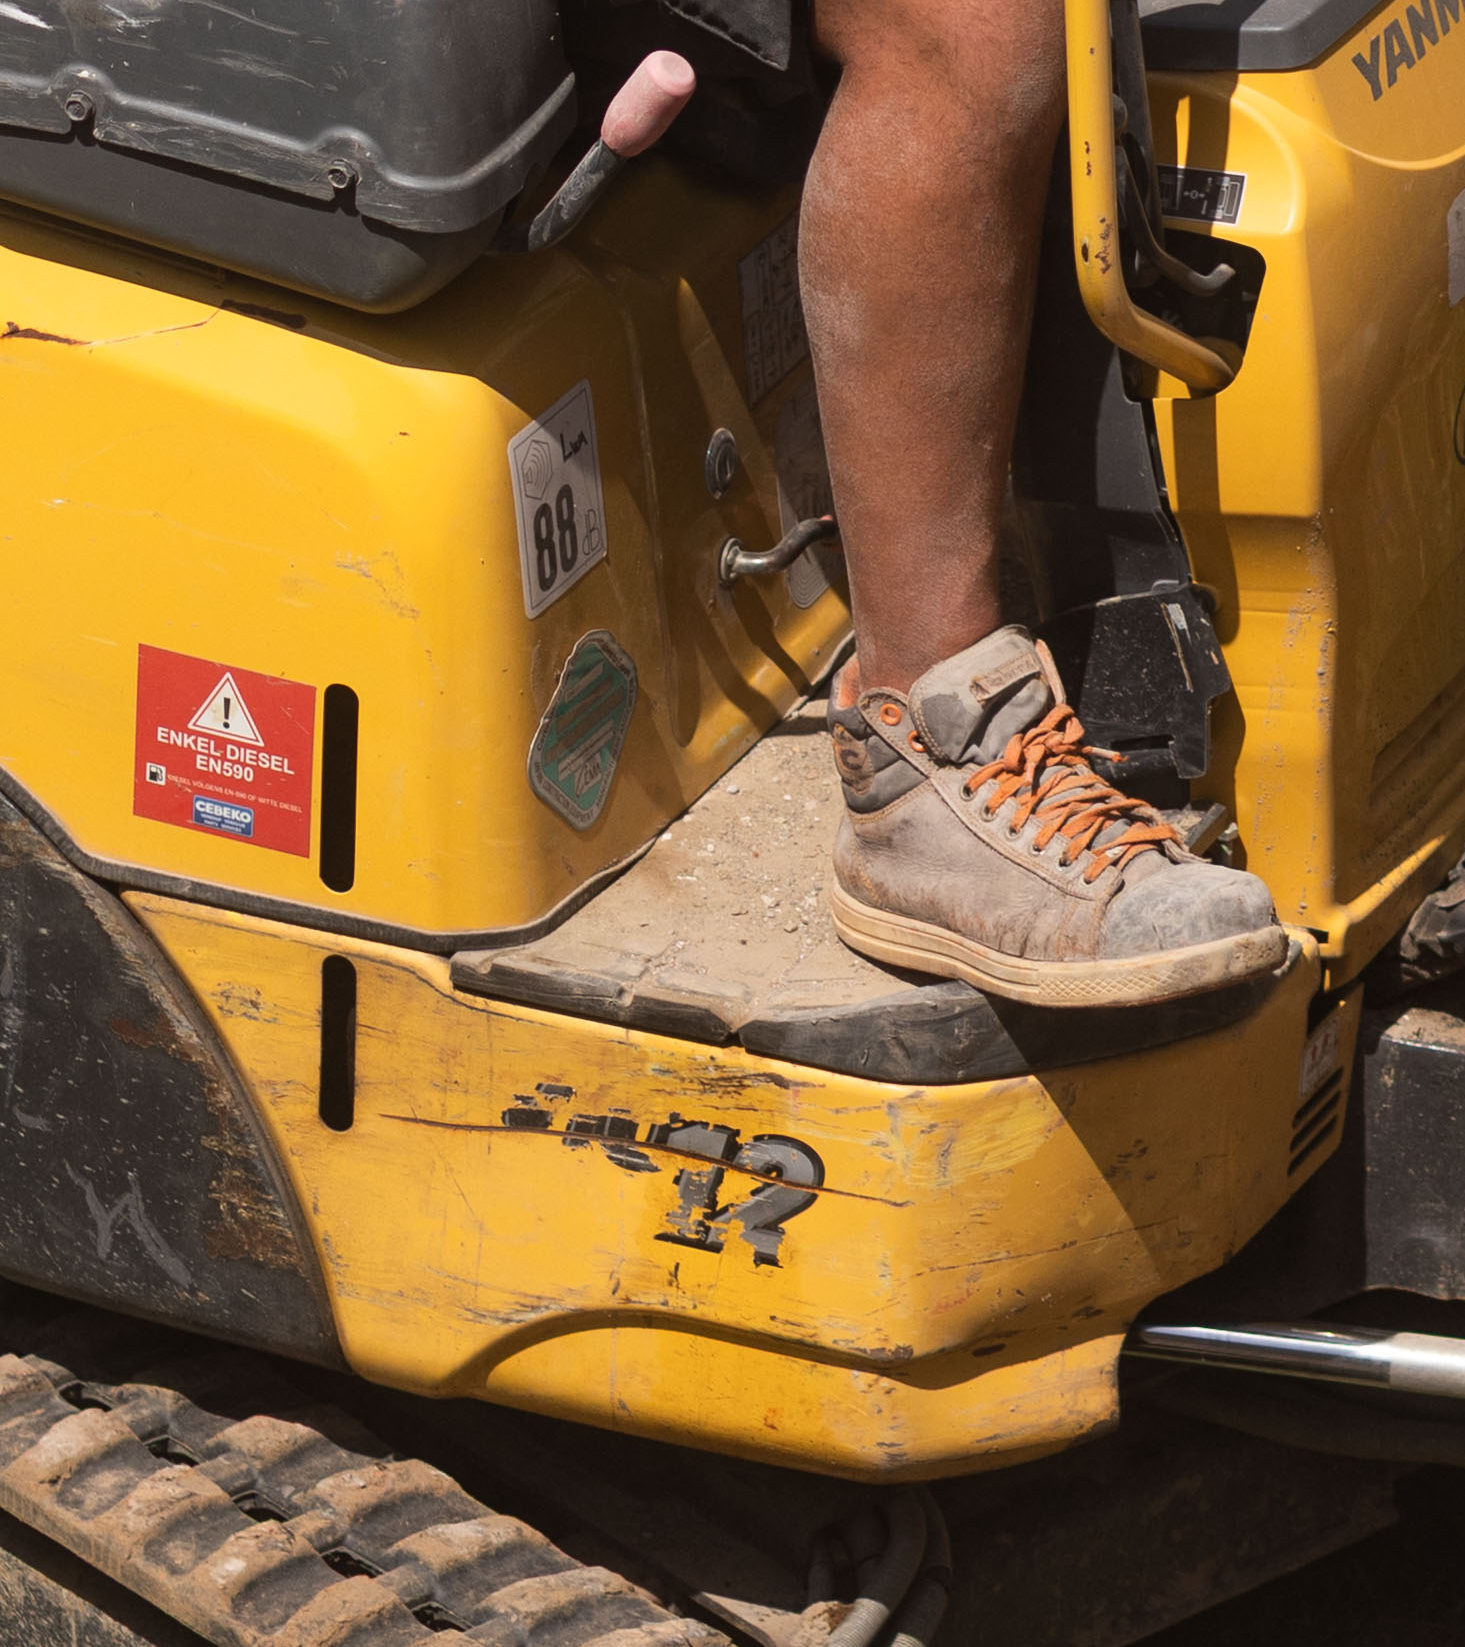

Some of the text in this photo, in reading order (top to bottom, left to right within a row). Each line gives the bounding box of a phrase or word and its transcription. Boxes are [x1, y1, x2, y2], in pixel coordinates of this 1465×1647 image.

[533, 483, 601, 592] 88 dB
[156, 726, 295, 775] ENKEL DIESEL
[195, 755, 254, 783] EN590
[195, 800, 252, 824] CEBEKO
